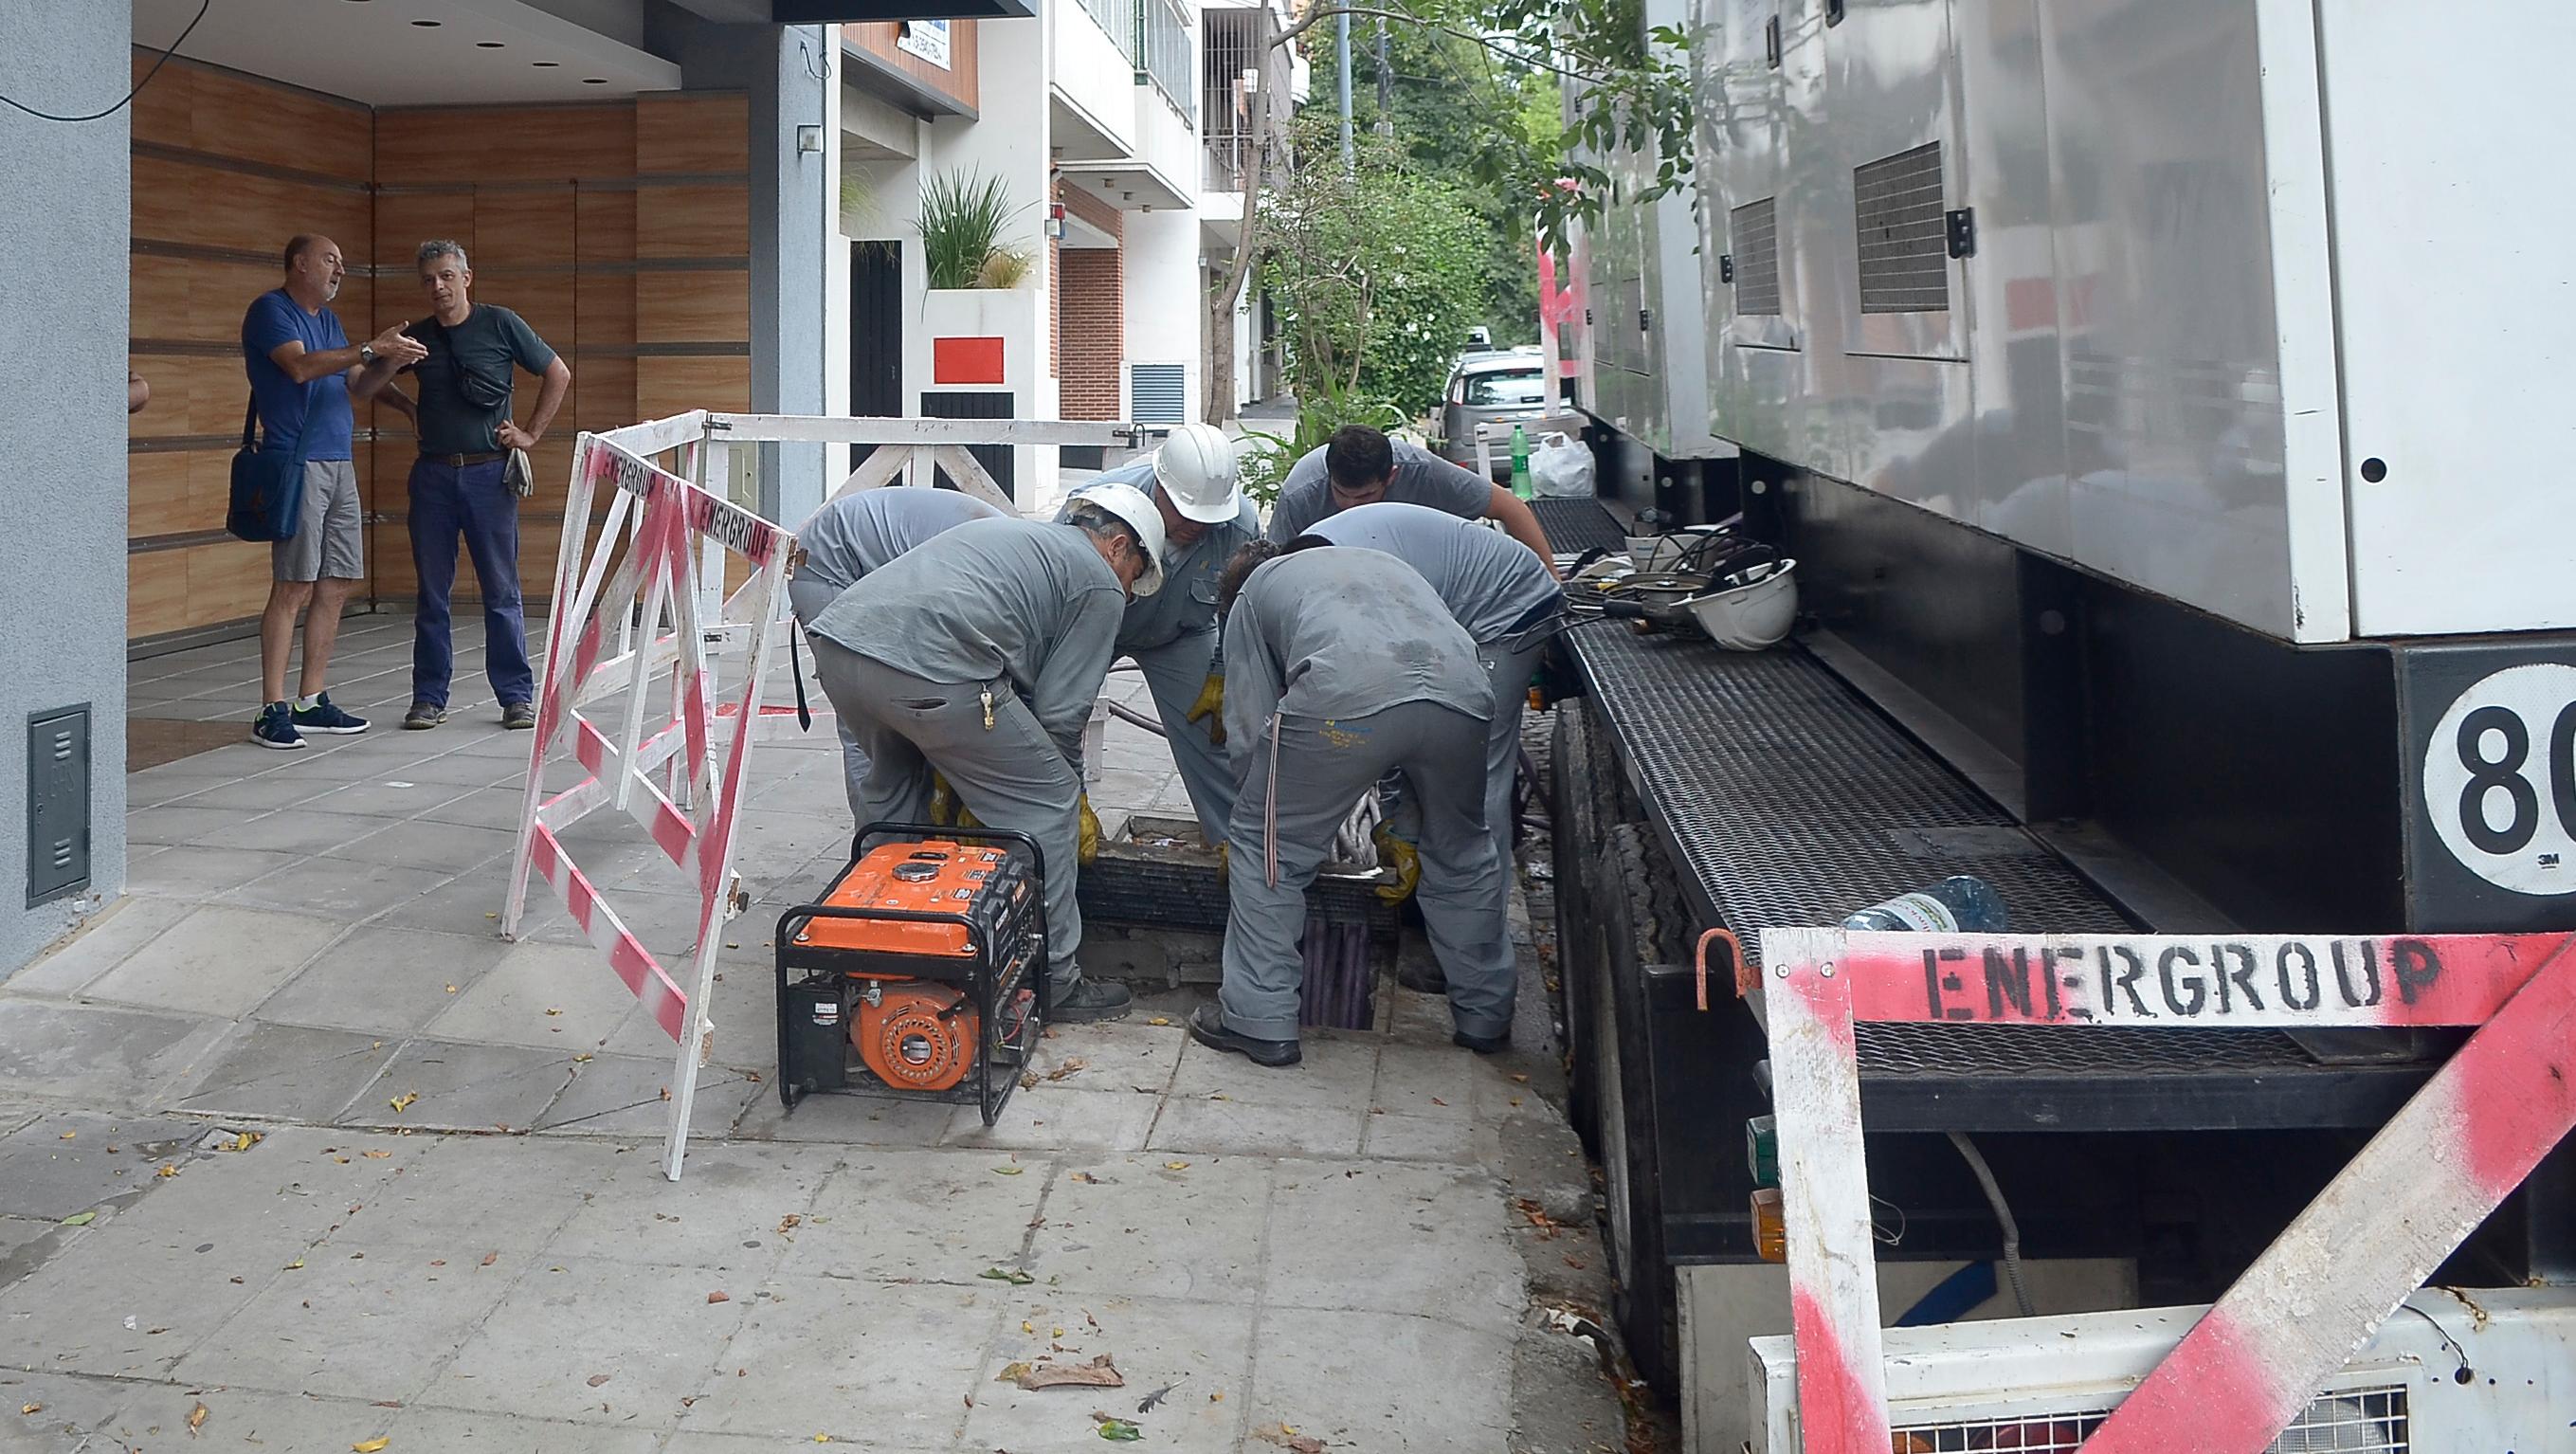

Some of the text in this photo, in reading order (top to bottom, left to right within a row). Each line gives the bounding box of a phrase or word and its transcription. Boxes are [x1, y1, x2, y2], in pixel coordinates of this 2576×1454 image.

[604, 451, 656, 500] ENERGROUP
[699, 500, 770, 561] ENERGROUP
[2537, 853, 2560, 865] 3M
[1923, 939, 2442, 1023] ENERGROUP
